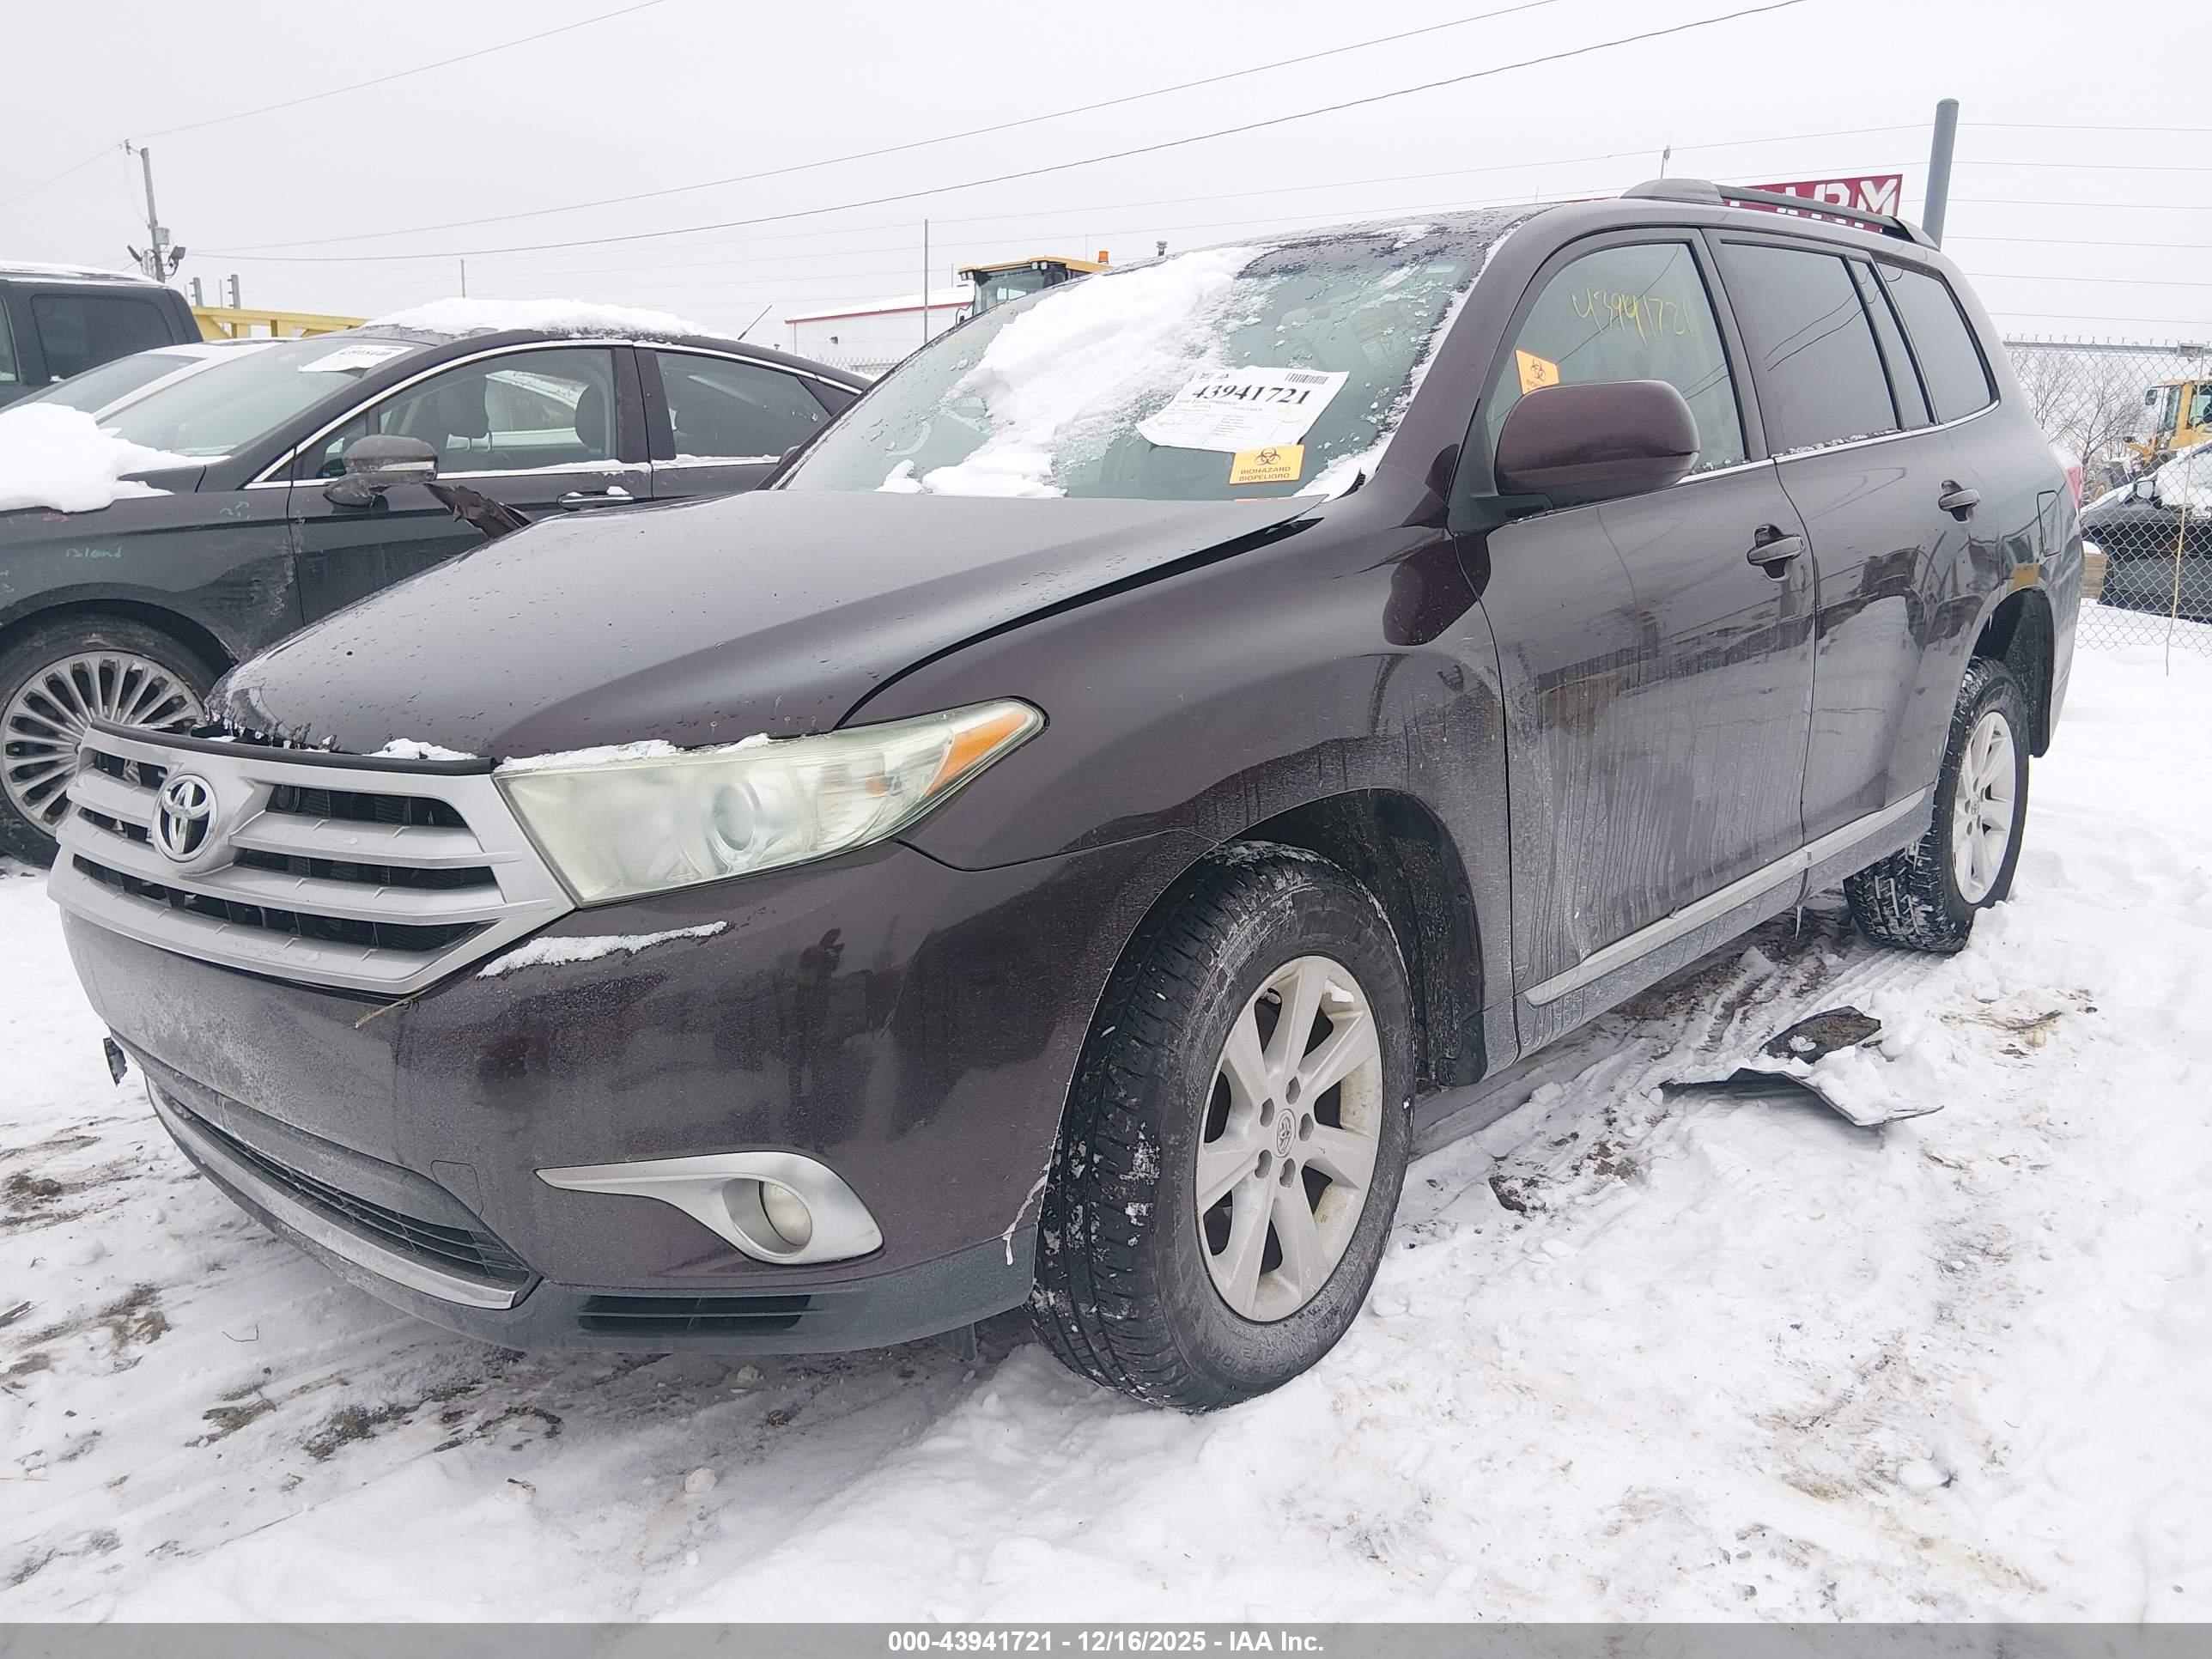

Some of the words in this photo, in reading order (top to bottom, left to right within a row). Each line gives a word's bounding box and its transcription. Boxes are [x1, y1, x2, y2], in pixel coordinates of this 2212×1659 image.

[1571, 288, 1693, 348] 43941721
[1192, 385, 1311, 404] 43941721
[1238, 473, 1290, 482] BIOPELIGRO
[1240, 466, 1291, 475] BIOHAZARD
